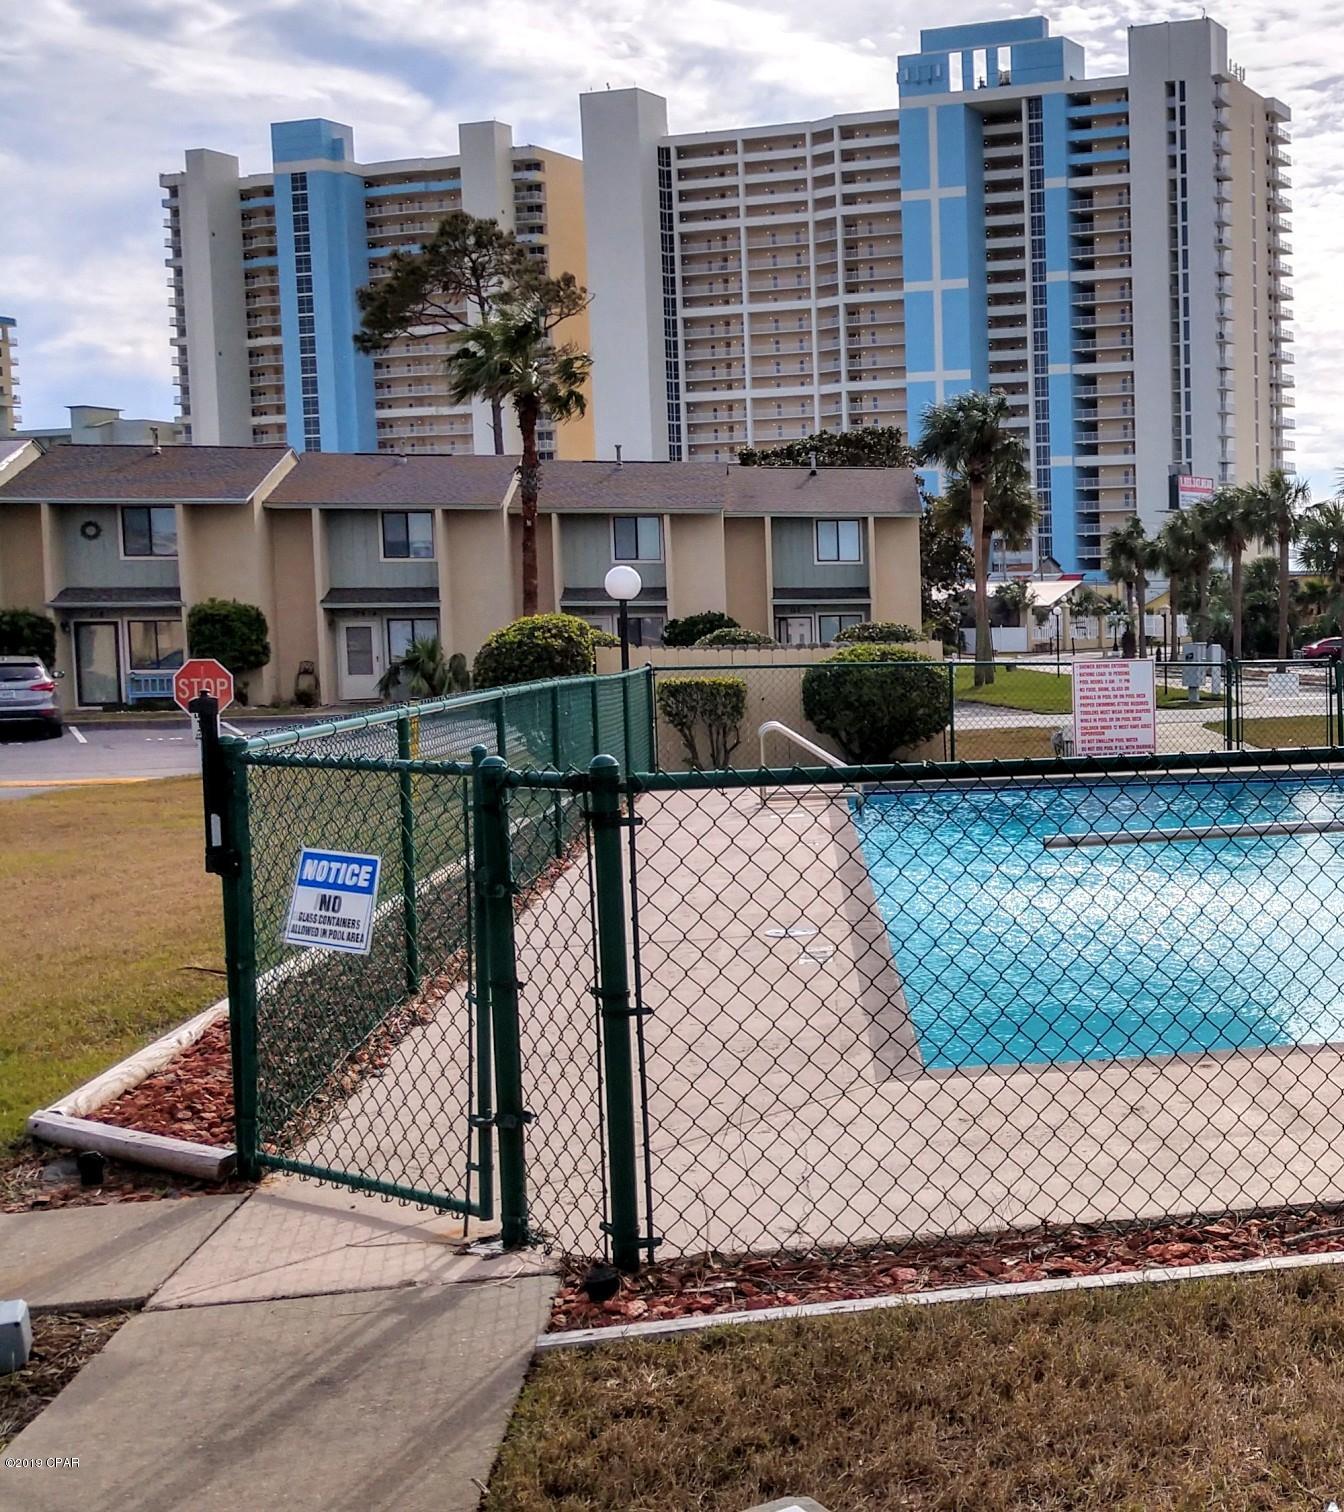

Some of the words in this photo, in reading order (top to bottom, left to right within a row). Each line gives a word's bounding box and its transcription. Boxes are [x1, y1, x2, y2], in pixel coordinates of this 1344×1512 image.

[178, 678, 228, 698] STOP
[302, 858, 373, 887] NOTICE
[319, 894, 342, 913] NO
[298, 912, 318, 923] GLASS
[318, 915, 360, 930] CONTAINERS
[291, 924, 319, 937] ALLOWED
[320, 928, 327, 938] IN
[328, 929, 345, 941] POOL
[346, 932, 364, 943] AREA
